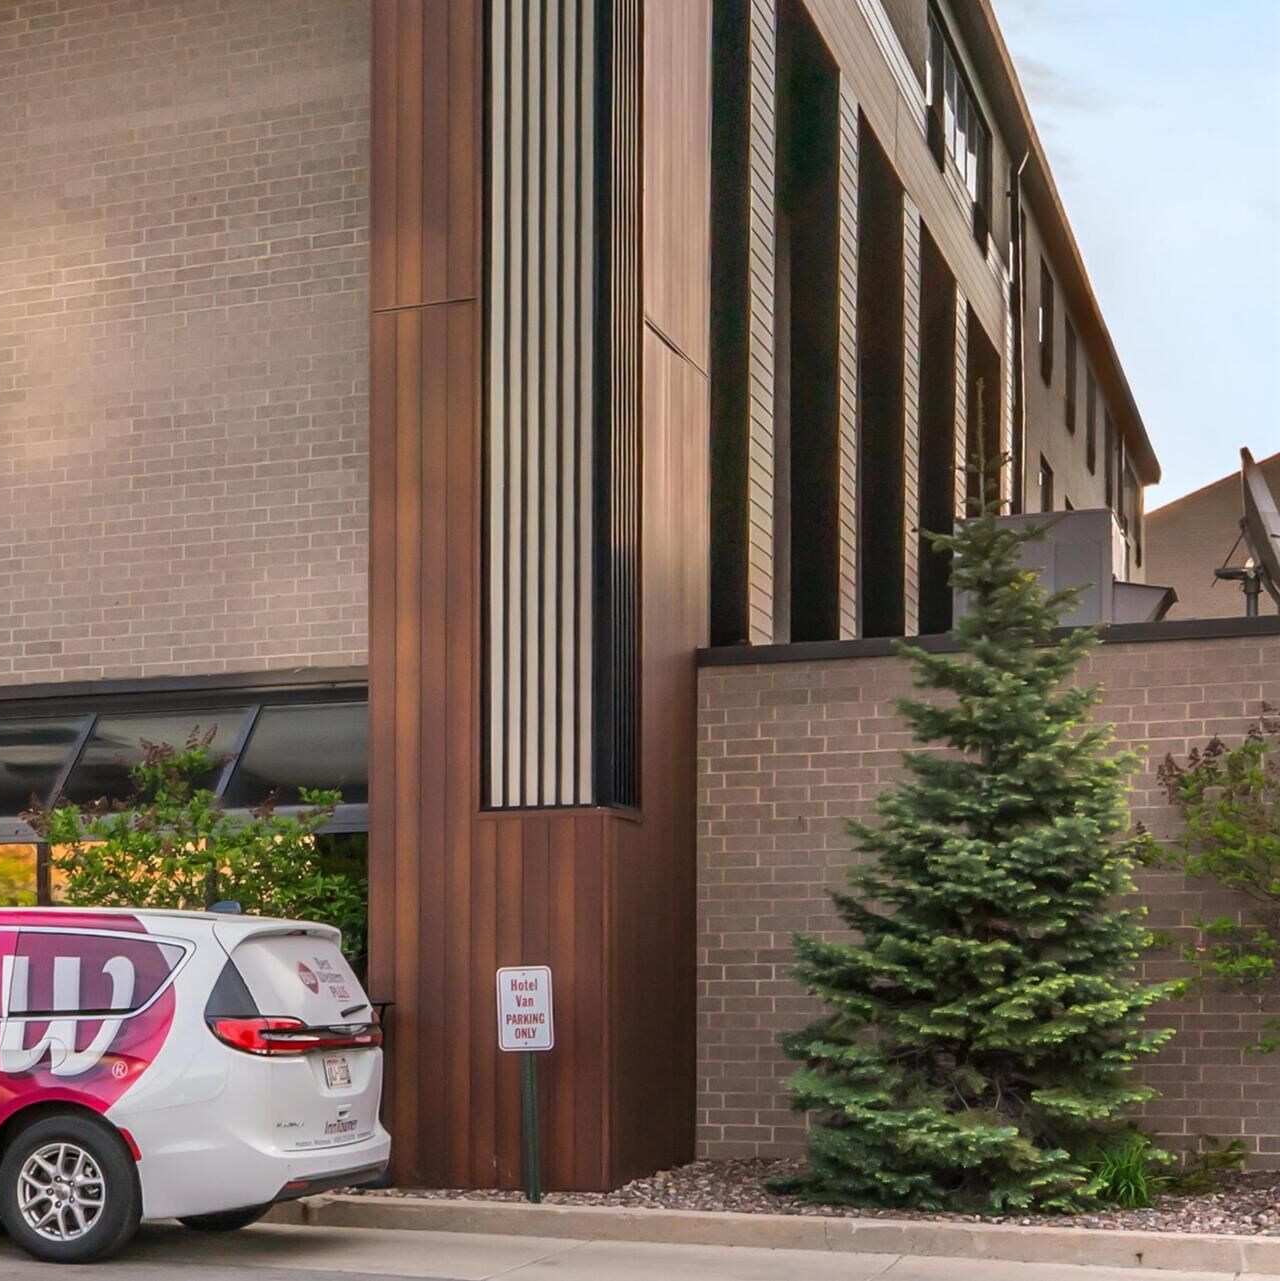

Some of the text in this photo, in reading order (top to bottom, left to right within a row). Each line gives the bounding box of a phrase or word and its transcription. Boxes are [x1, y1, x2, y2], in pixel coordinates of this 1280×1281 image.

[511, 978, 538, 992] Hotel
[515, 995, 534, 1008] Van
[506, 1013, 545, 1025] PARKING
[514, 1028, 537, 1040] ONLY
